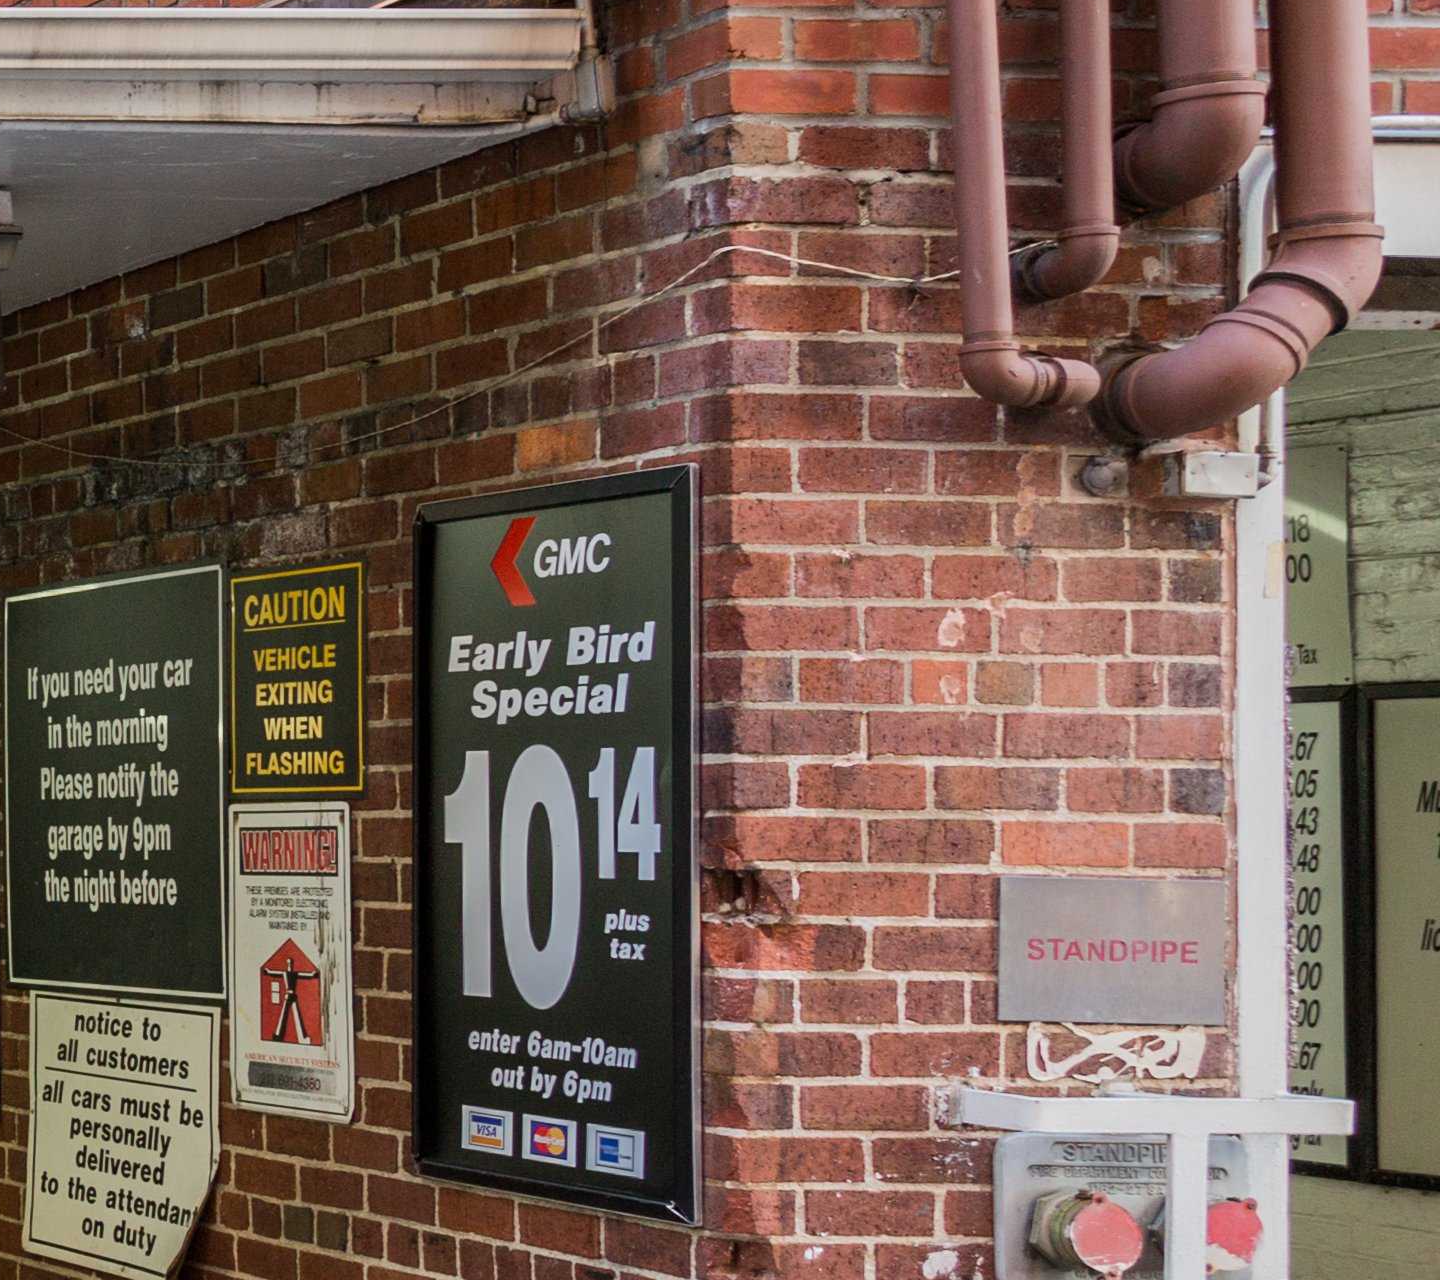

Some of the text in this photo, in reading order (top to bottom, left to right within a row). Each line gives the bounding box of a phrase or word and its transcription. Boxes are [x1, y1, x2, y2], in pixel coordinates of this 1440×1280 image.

[534, 533, 611, 578] GMC
[245, 586, 345, 627] CAUTION
[253, 644, 336, 671] VEHICLE
[448, 621, 656, 677] Early Bird
[1296, 645, 1318, 664] Tax
[27, 658, 193, 708] If you need your car
[255, 680, 333, 706] EXITING
[471, 673, 629, 725] Special
[48, 708, 168, 752] in the morning
[264, 716, 322, 740] WHEN
[246, 750, 344, 776] FLASHING
[41, 762, 179, 807] Please notify the
[48, 817, 171, 860] garage by 9pm
[242, 829, 337, 872] WARNING!
[45, 869, 177, 912] the night before
[444, 744, 661, 1010] 10 14
[605, 909, 650, 933] plus
[610, 938, 644, 960] tax
[1027, 938, 1199, 964] STANDPIPE
[74, 1012, 161, 1041] notice to
[57, 1040, 189, 1079] all customers
[468, 1029, 637, 1068] enter 6am-10am
[42, 1080, 204, 1128] all cars must be
[491, 1066, 612, 1103] out by 6pm
[70, 1117, 171, 1158] personally
[476, 1124, 497, 1138] VISA
[76, 1145, 165, 1185] delivered
[1063, 1143, 1168, 1163] STANDPI
[40, 1172, 59, 1195] to
[68, 1177, 97, 1204] the
[82, 1216, 156, 1256] on duty
